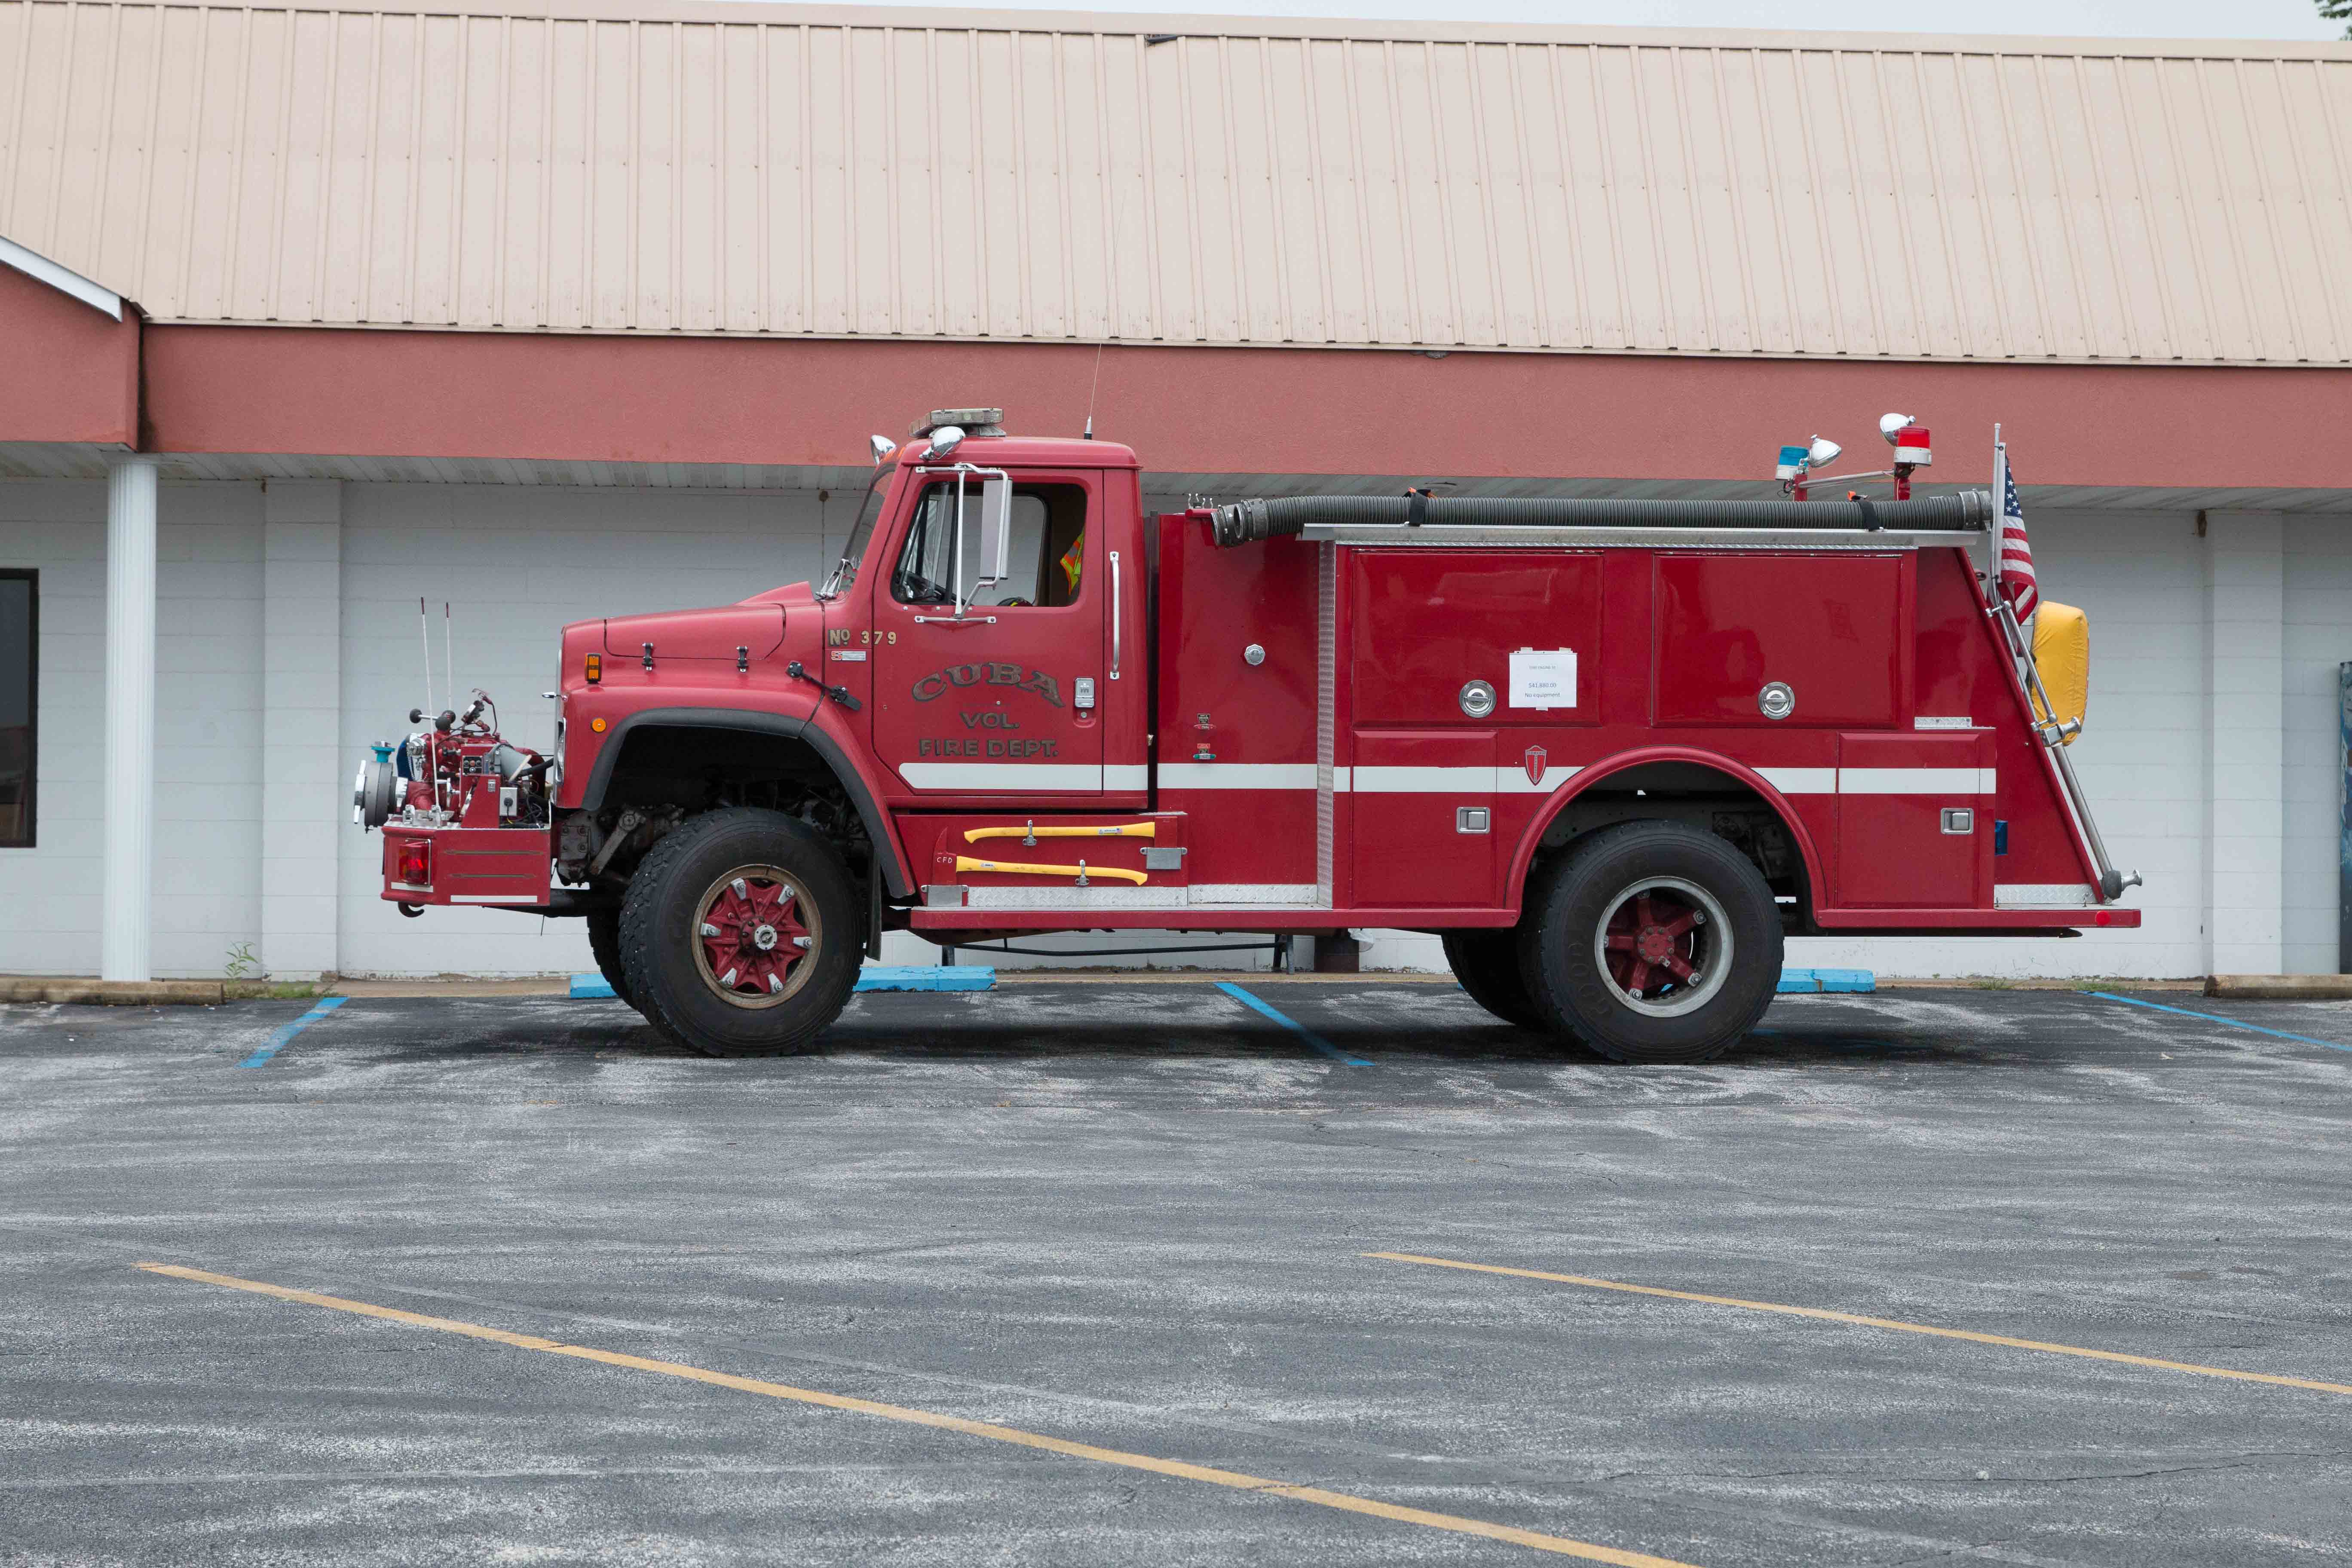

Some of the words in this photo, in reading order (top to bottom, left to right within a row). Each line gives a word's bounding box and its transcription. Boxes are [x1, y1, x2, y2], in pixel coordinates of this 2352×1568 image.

[861, 631, 897, 645] 379
[912, 662, 1065, 707] CUBA
[959, 712, 1020, 729] VOL.
[919, 739, 980, 757] FIRE
[986, 739, 1059, 757] DEPT.
